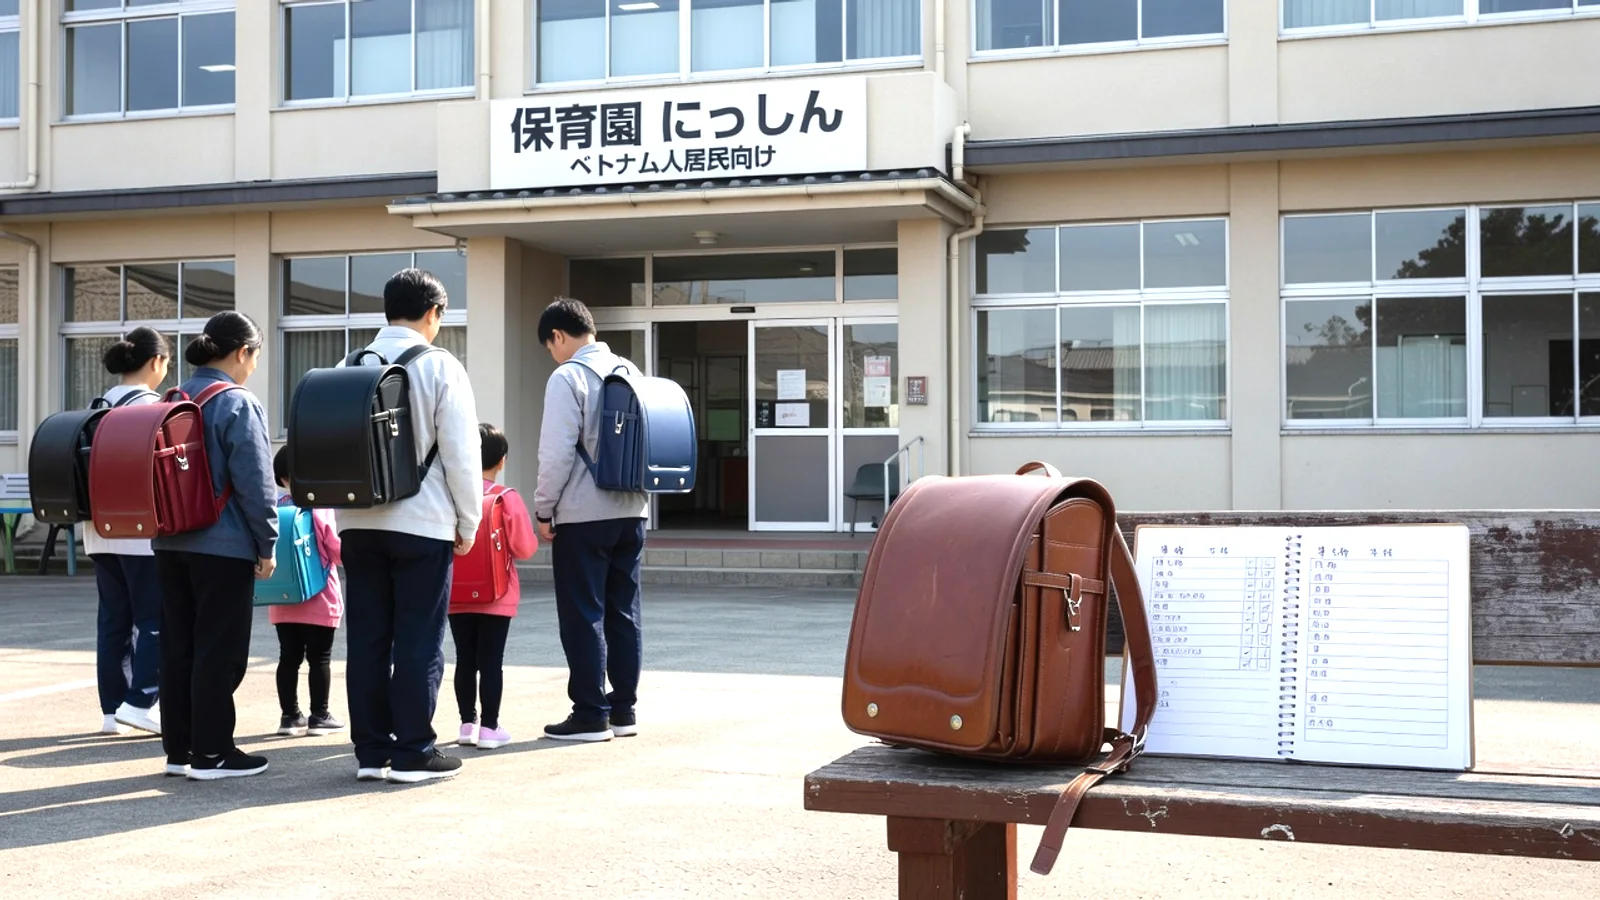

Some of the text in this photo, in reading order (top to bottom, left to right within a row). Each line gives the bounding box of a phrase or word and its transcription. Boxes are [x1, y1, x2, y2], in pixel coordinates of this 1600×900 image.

[510, 90, 843, 153] 保育園 にっしん
[570, 145, 776, 176] ベトナム人居民向け
